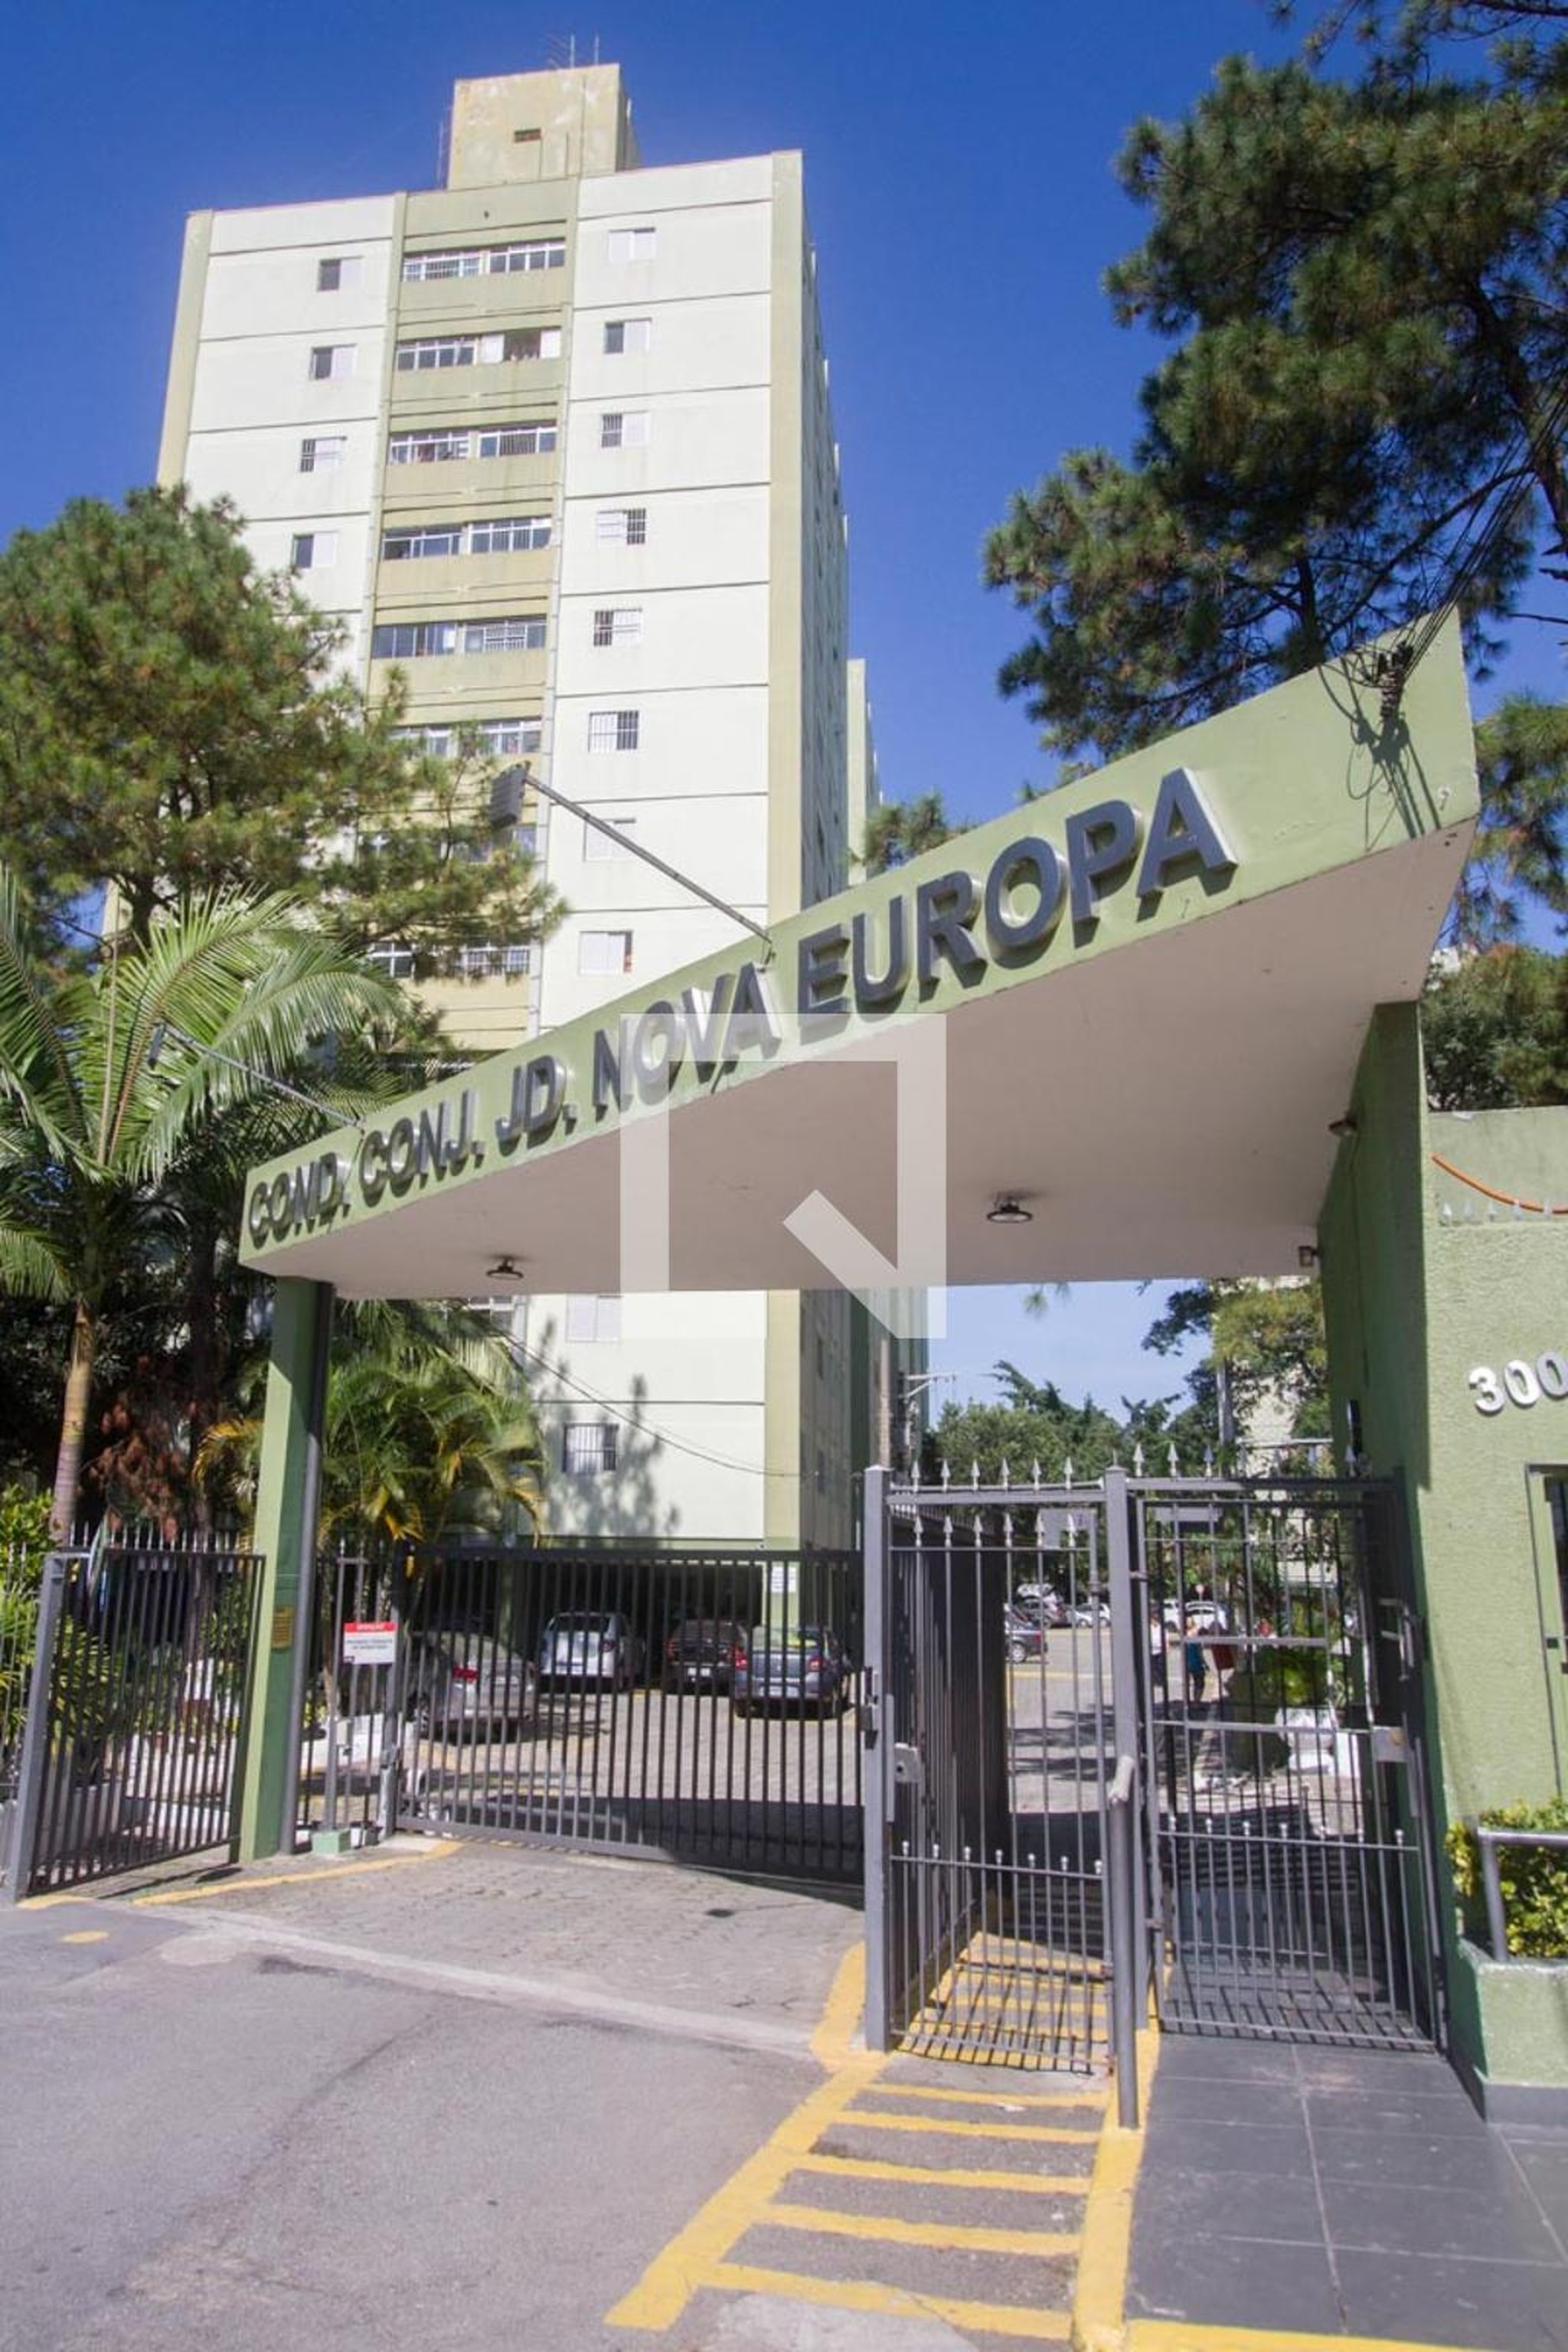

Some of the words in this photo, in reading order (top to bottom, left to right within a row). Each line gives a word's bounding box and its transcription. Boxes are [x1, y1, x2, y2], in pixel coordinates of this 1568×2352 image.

[249, 1152, 351, 1240] COND.
[358, 1089, 485, 1200] CONJ.
[495, 1054, 579, 1145] JD.
[592, 962, 782, 1107] NOVA
[797, 766, 1238, 1027] EUROPA
[1468, 1351, 1568, 1413] 300
